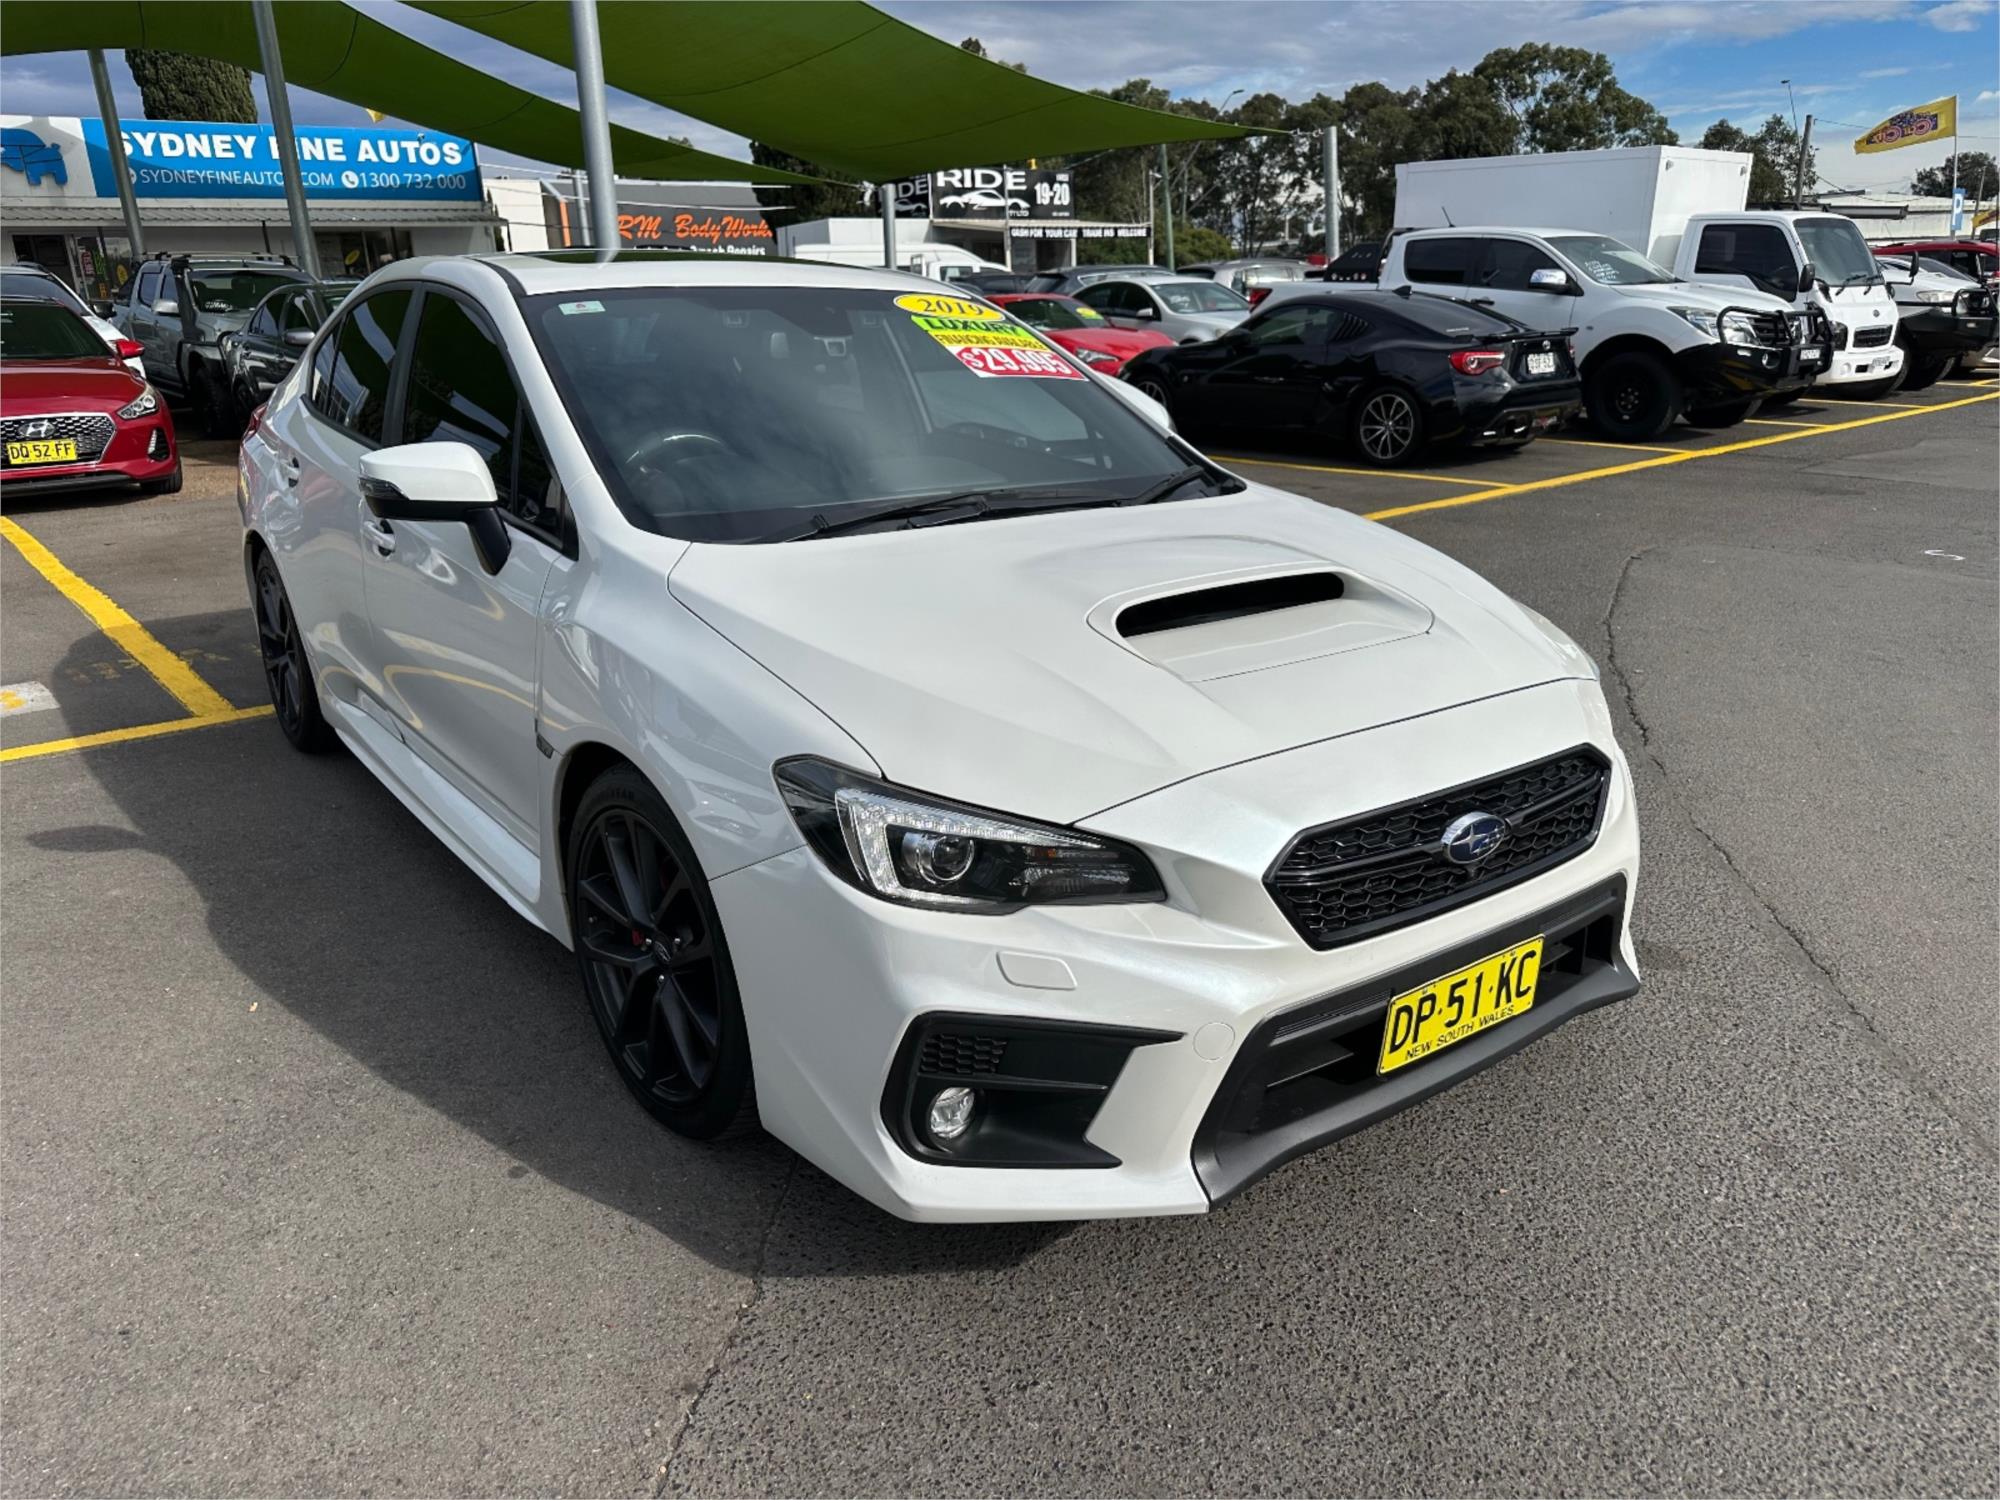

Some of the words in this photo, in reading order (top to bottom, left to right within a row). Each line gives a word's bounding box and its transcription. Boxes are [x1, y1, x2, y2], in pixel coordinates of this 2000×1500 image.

[357, 139, 462, 166] AUTOS
[359, 172, 400, 188] 1300
[403, 173, 433, 188] 732
[437, 174, 466, 190] 000
[936, 168, 1028, 191] RIDE
[1034, 182, 1070, 207] 19-20
[917, 299, 984, 316] 2019
[924, 318, 1017, 335] LUXURY
[961, 347, 1073, 375] $29,995
[1405, 1040, 1432, 1061] NEW
[1436, 1023, 1473, 1047] SOUTH
[1479, 1004, 1516, 1027] WALES
